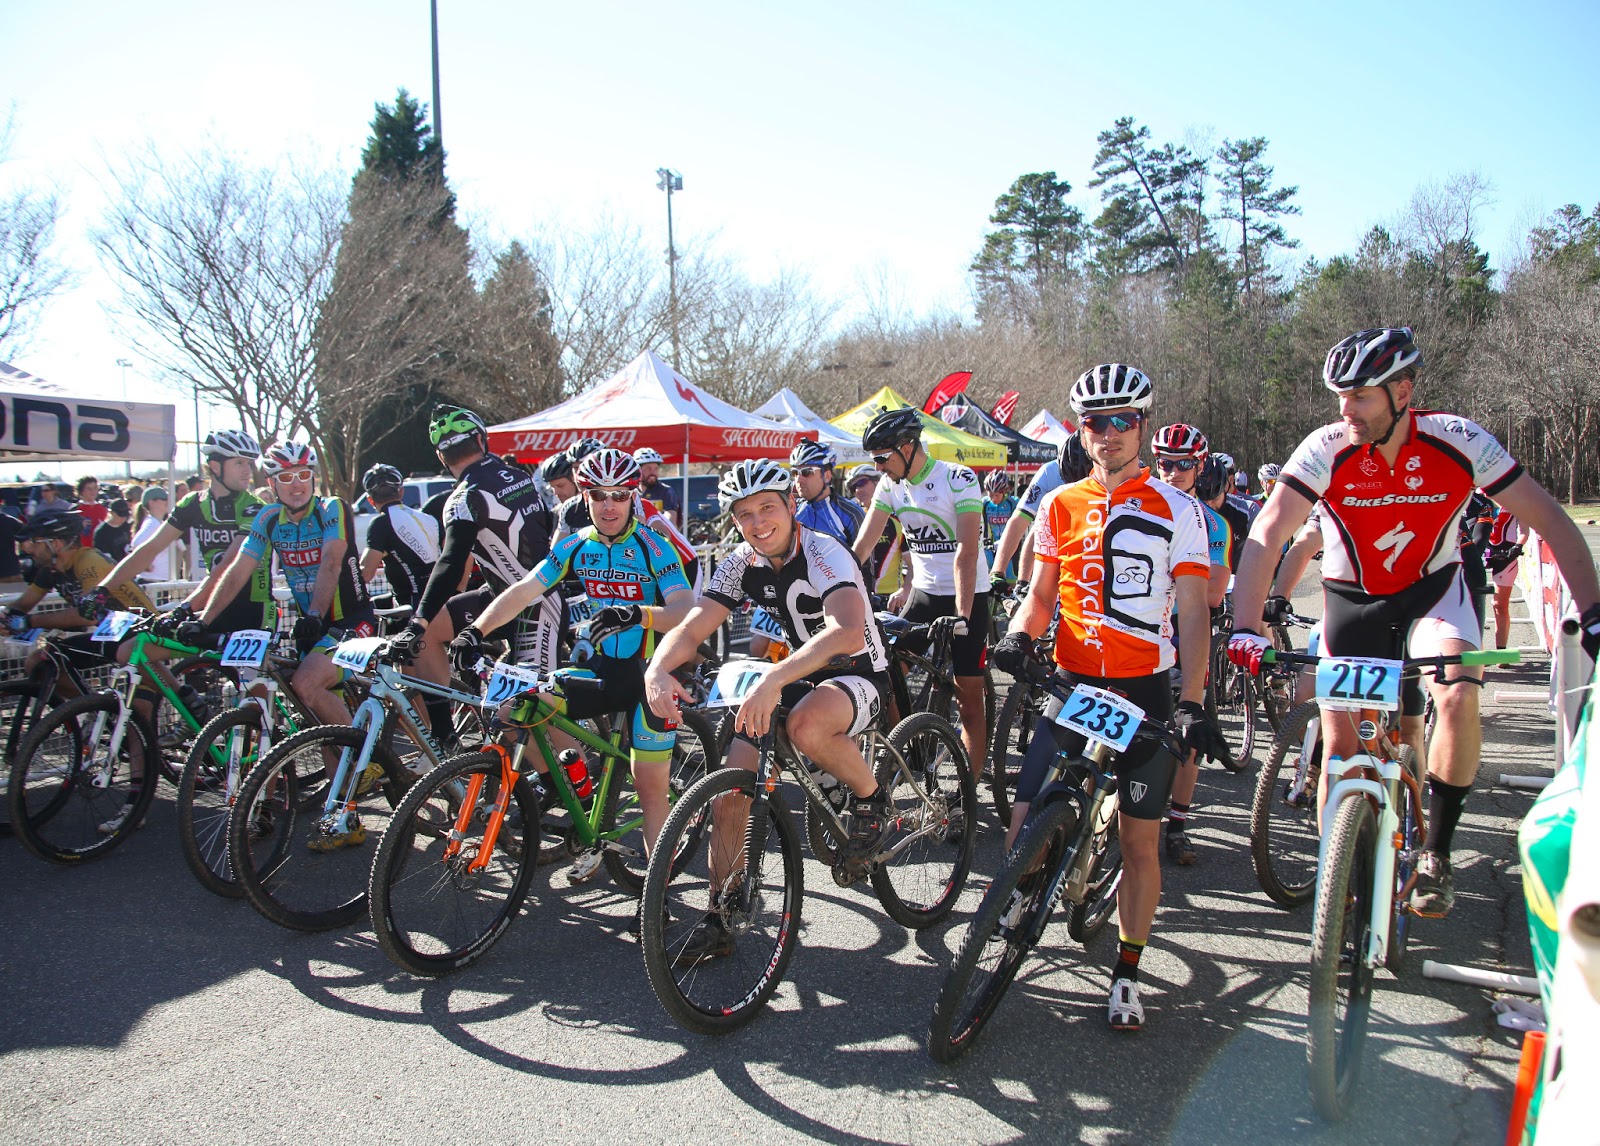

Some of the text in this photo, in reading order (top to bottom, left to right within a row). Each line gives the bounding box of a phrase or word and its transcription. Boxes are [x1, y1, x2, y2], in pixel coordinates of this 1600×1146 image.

[721, 428, 797, 449] SPECIALIZED
[288, 550, 320, 565] CLIF
[397, 525, 431, 562] LUNA
[1075, 494, 1110, 651] TotalCyclist
[595, 583, 638, 598] CLIF
[570, 601, 591, 624] 09
[227, 638, 262, 661] 222
[1329, 663, 1388, 701] 212
[1068, 696, 1130, 740] 233
[745, 942, 784, 1005] ZTR FLOW
